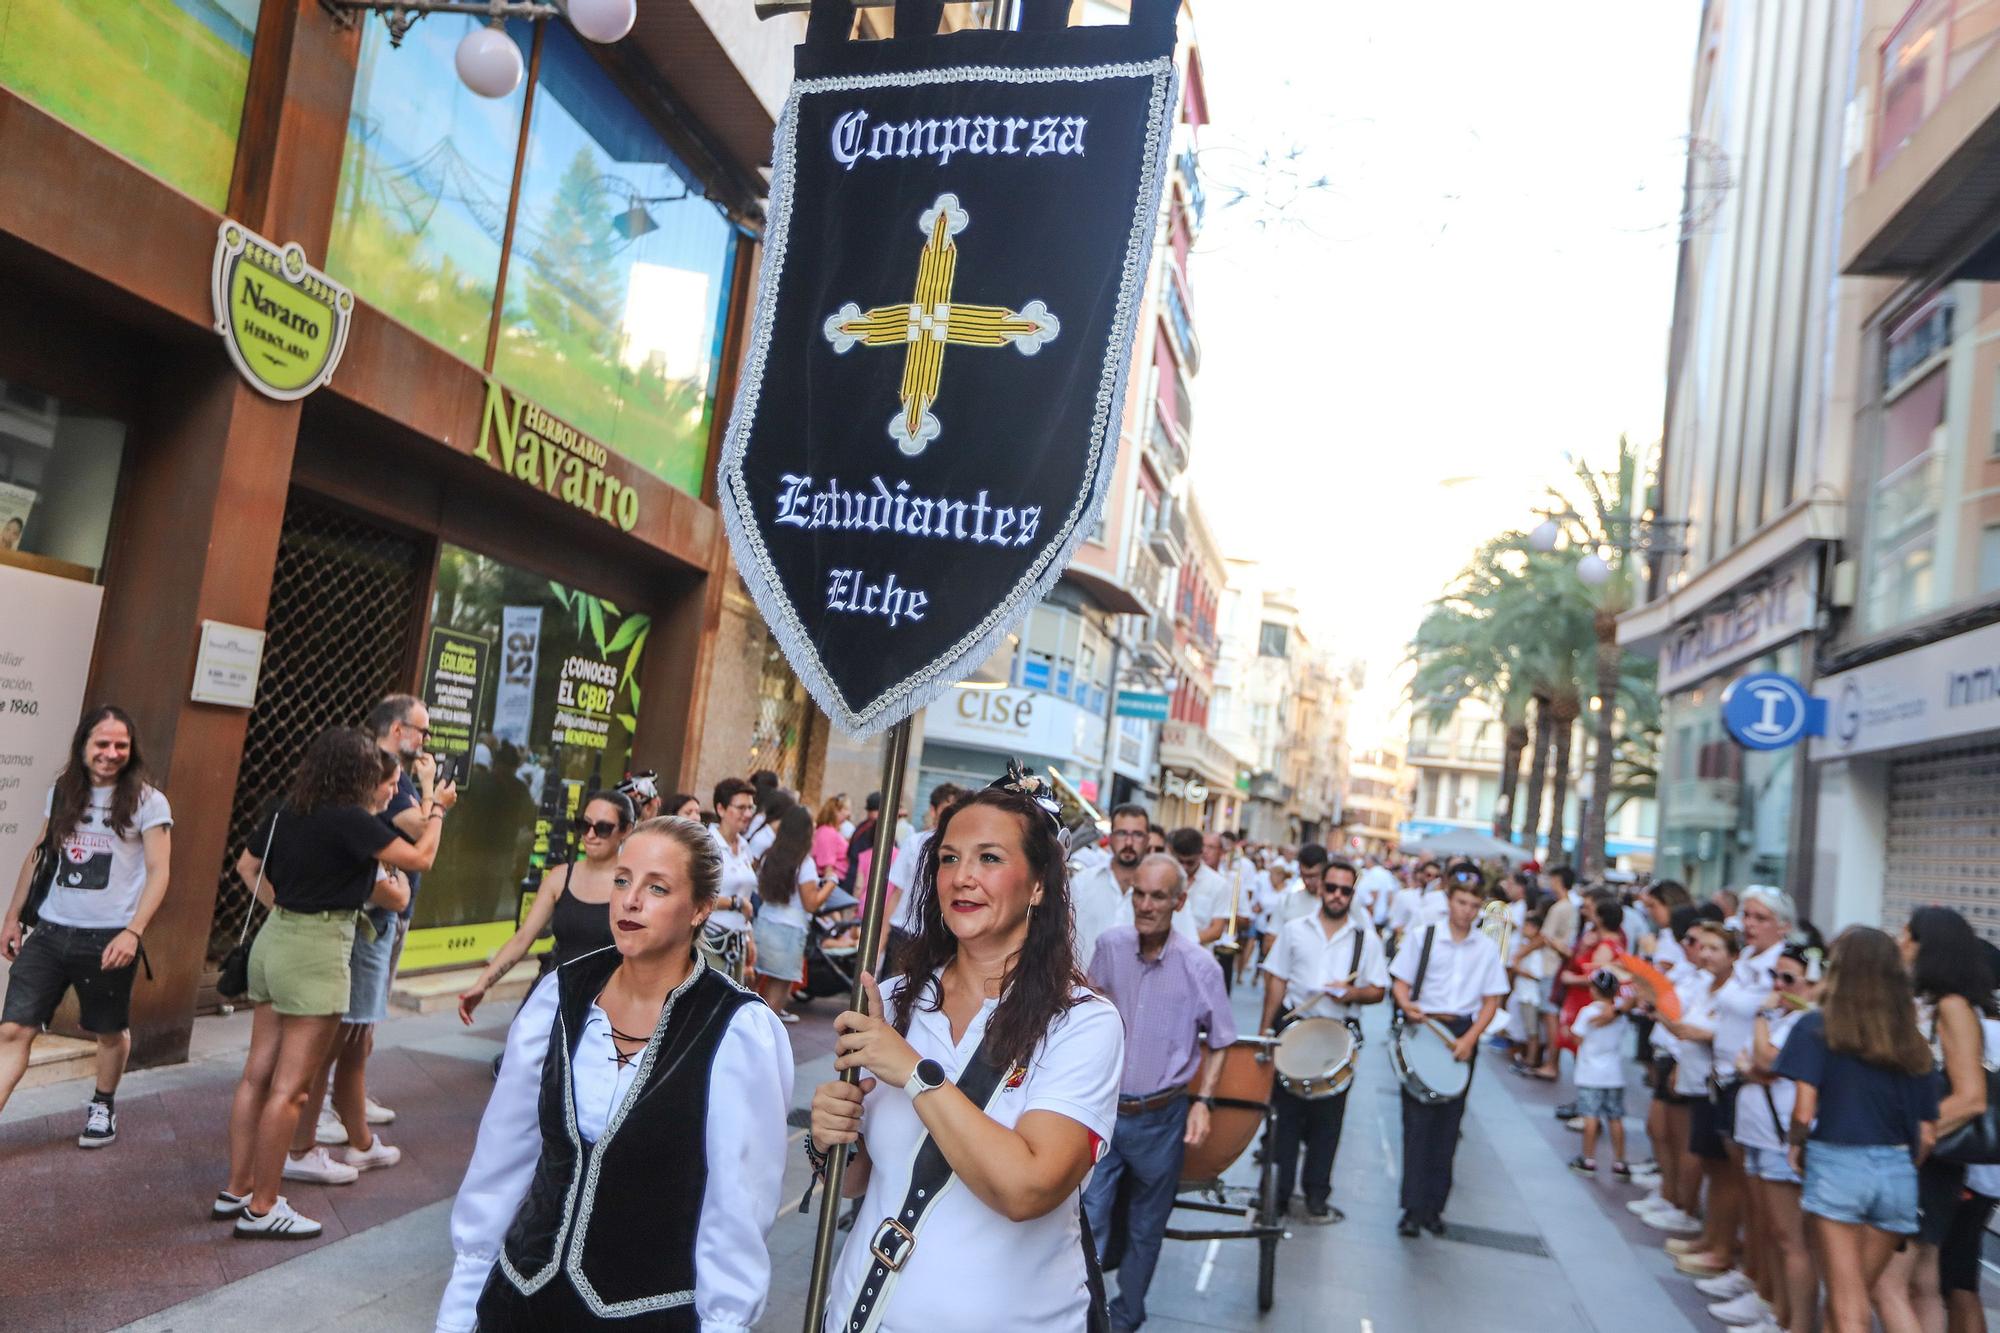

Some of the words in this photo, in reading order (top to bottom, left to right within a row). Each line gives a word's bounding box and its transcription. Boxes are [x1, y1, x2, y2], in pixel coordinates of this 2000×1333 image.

[831, 110, 1088, 171] Comparsa
[241, 276, 320, 341] Navarro
[243, 319, 309, 362] HERBOLARIO
[473, 377, 639, 532] Navarro
[524, 402, 608, 469] HERBOLARIO
[774, 474, 1042, 547] Estudiantes
[826, 568, 929, 628] Elche
[557, 680, 575, 707] EL
[577, 682, 615, 714] CBD?
[560, 656, 618, 687] ¿CONOCES
[10, 699, 39, 716] 1960,
